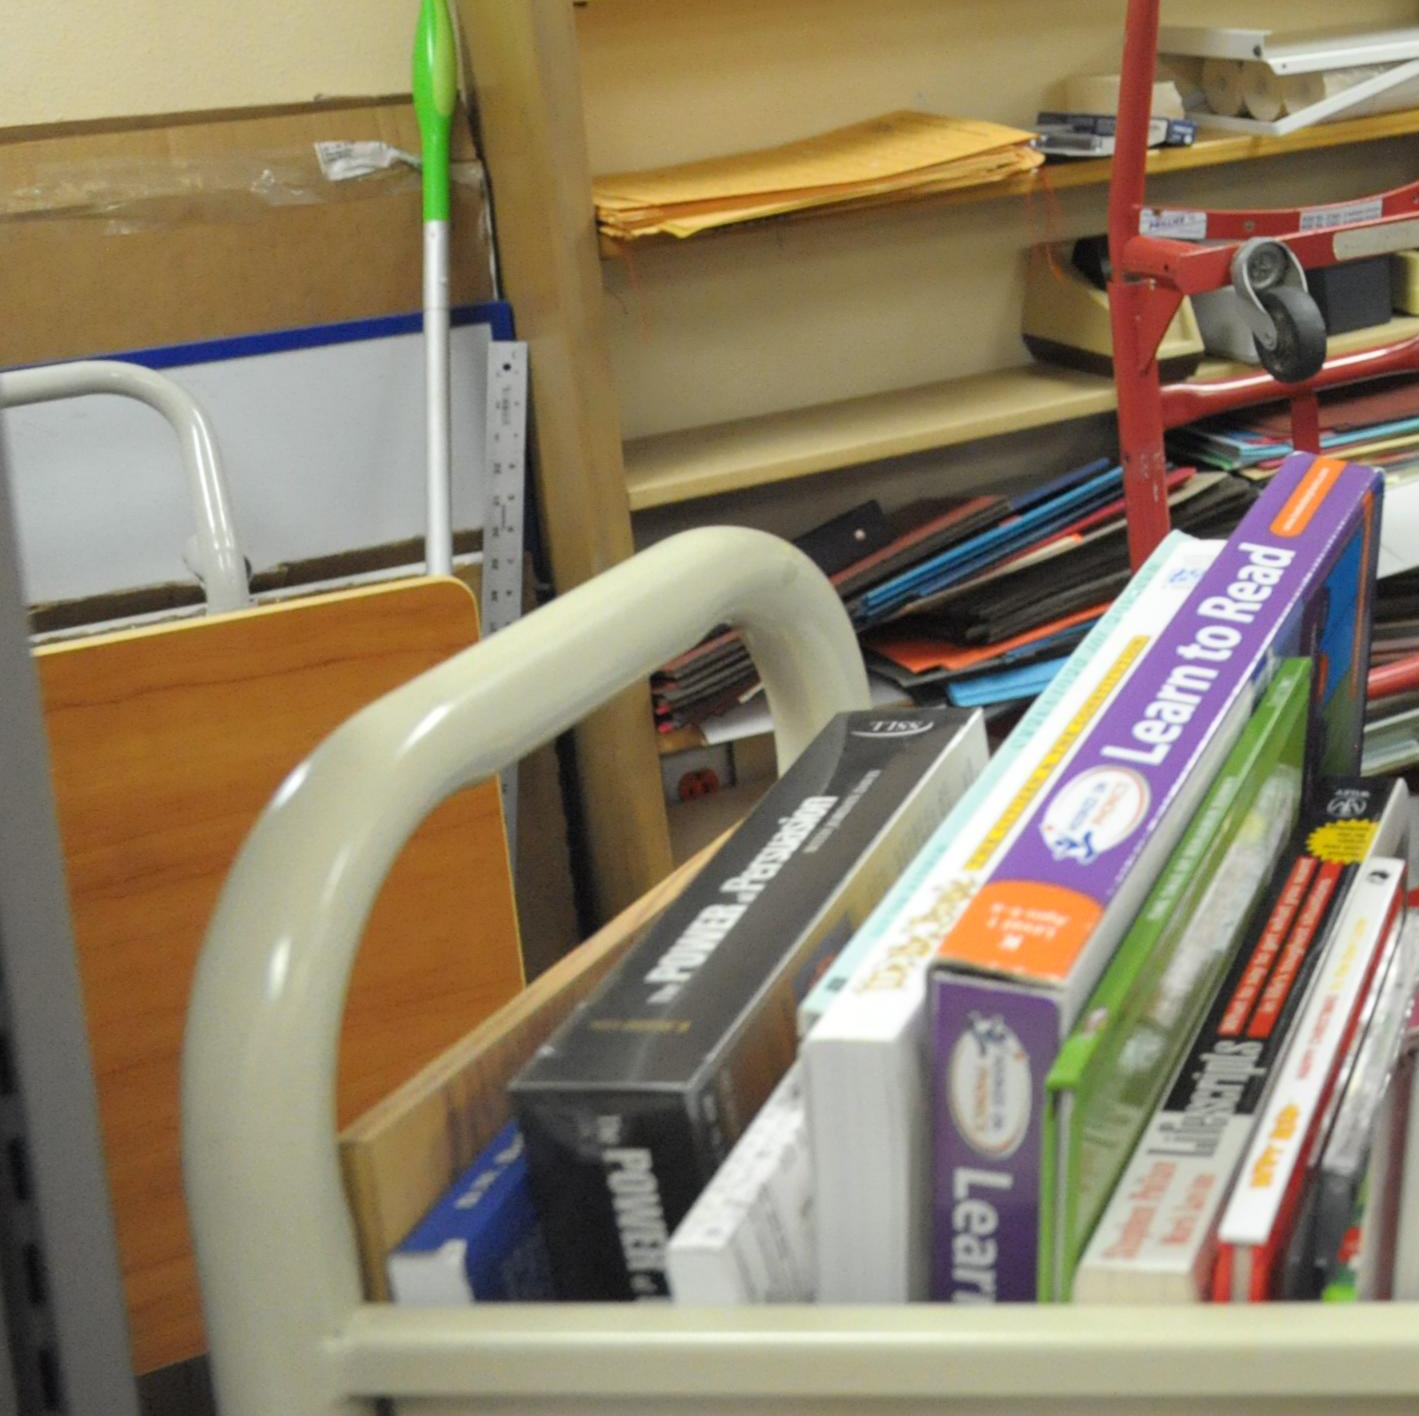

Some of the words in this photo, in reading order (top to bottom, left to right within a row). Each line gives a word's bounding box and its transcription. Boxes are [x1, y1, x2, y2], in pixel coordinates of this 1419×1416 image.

[1196, 543, 1296, 623] Read
[1177, 618, 1244, 674] to
[1100, 657, 1219, 765] Learn
[654, 902, 732, 984] POWER
[720, 794, 838, 901] Persuasion
[1222, 999, 1250, 1031] What
[1148, 1039, 1264, 1159] Lifescripts
[601, 1147, 670, 1271] POWER
